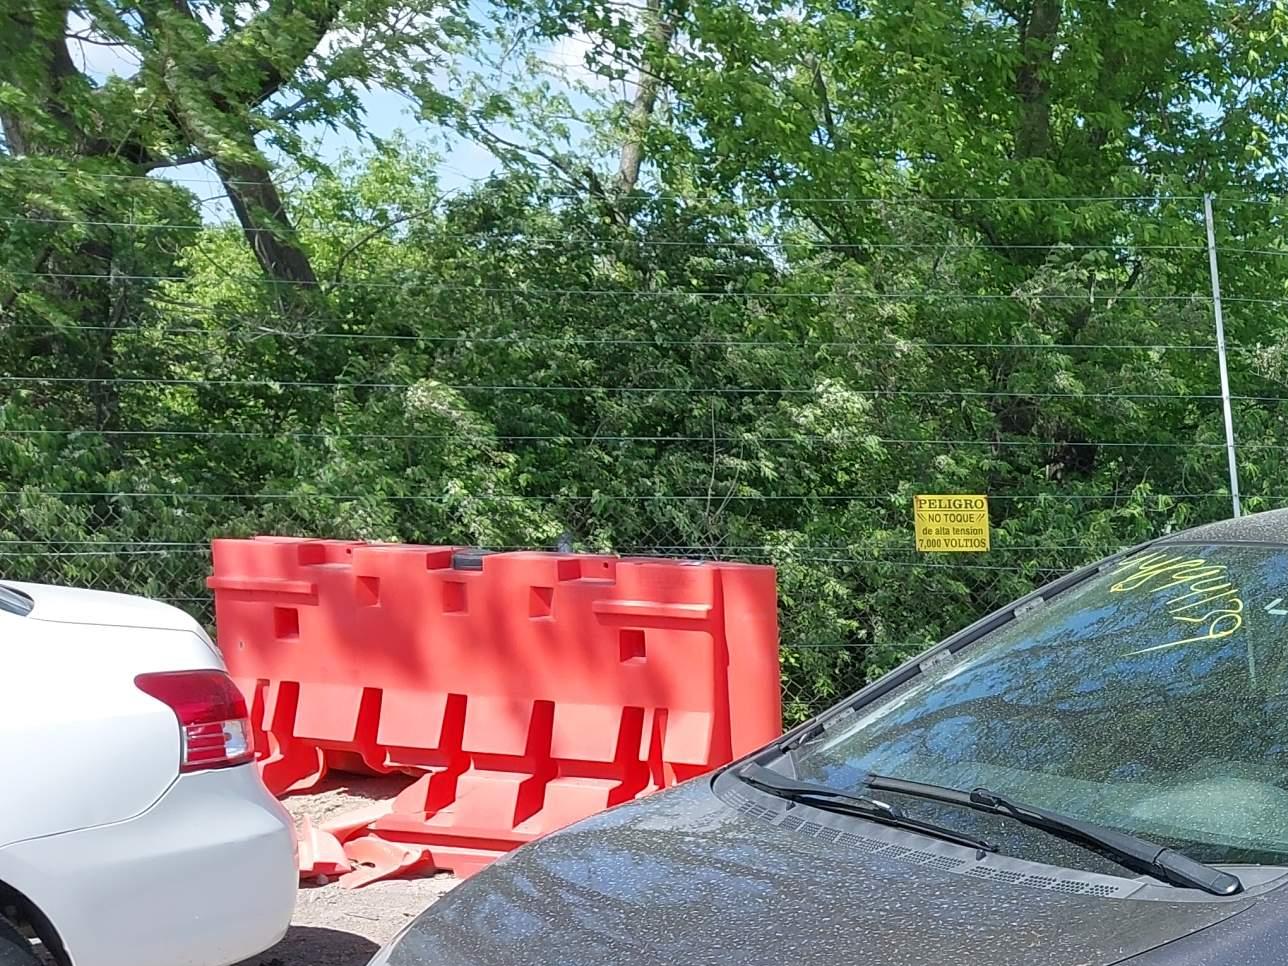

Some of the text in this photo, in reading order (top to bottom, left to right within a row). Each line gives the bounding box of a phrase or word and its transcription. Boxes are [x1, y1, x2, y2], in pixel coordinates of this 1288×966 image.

[918, 498, 985, 509] PELIGRO
[928, 513, 974, 523] NO TOQUE
[922, 526, 983, 535] de alta tension
[919, 538, 986, 549] 7,000 VOLTIOS
[1110, 547, 1244, 656] 44894139
